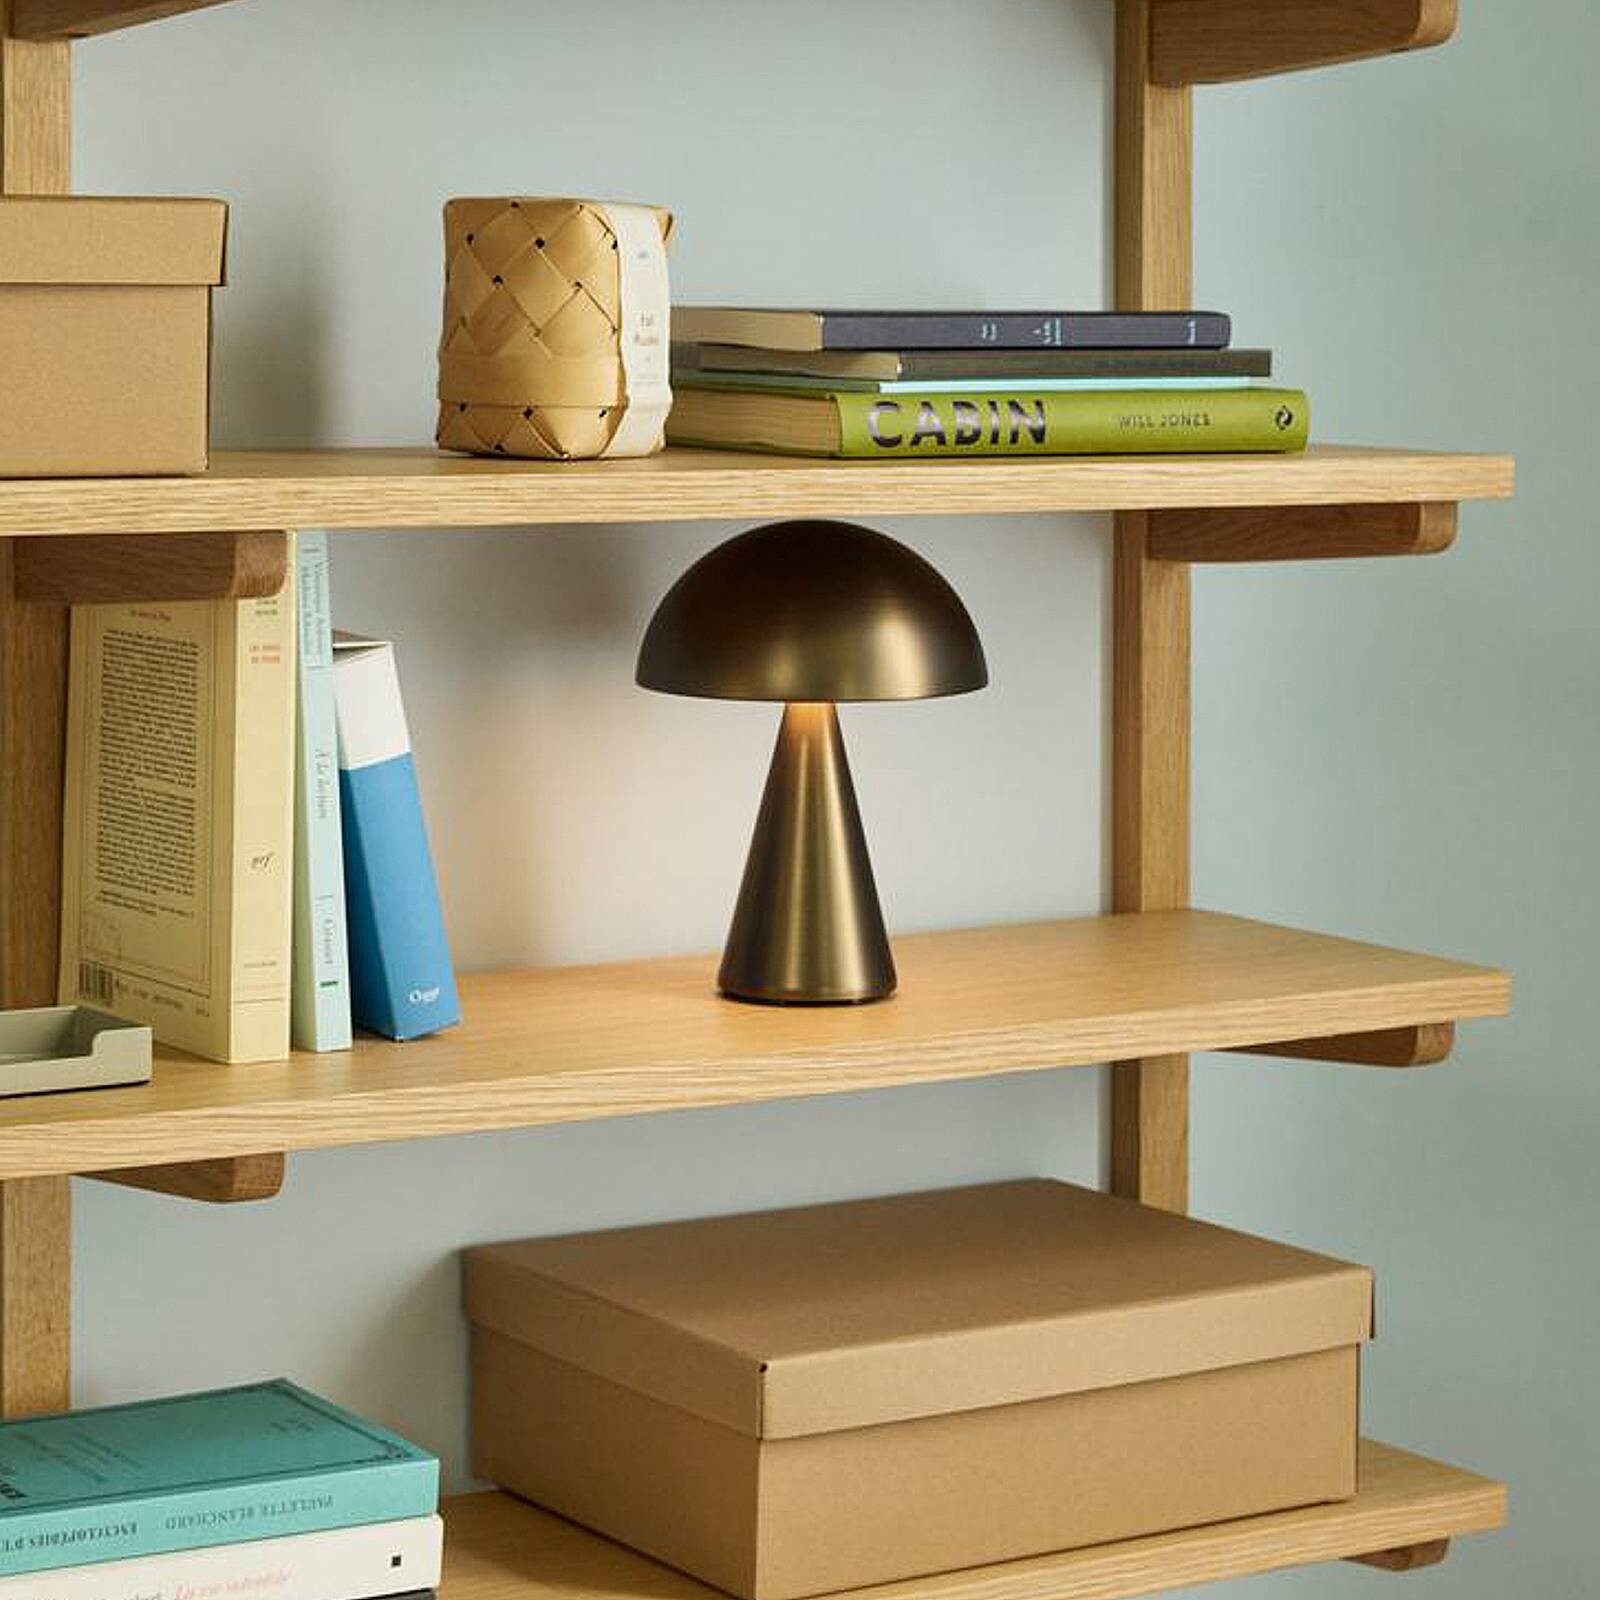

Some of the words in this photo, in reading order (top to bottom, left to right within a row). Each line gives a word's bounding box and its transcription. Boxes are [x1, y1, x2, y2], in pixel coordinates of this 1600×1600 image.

[867, 400, 1047, 448] CABIN
[1119, 413, 1154, 428] WILL
[1160, 411, 1212, 428] JONES
[261, 1494, 334, 1517] PAULETTE
[164, 1506, 255, 1530] BLANCHARD
